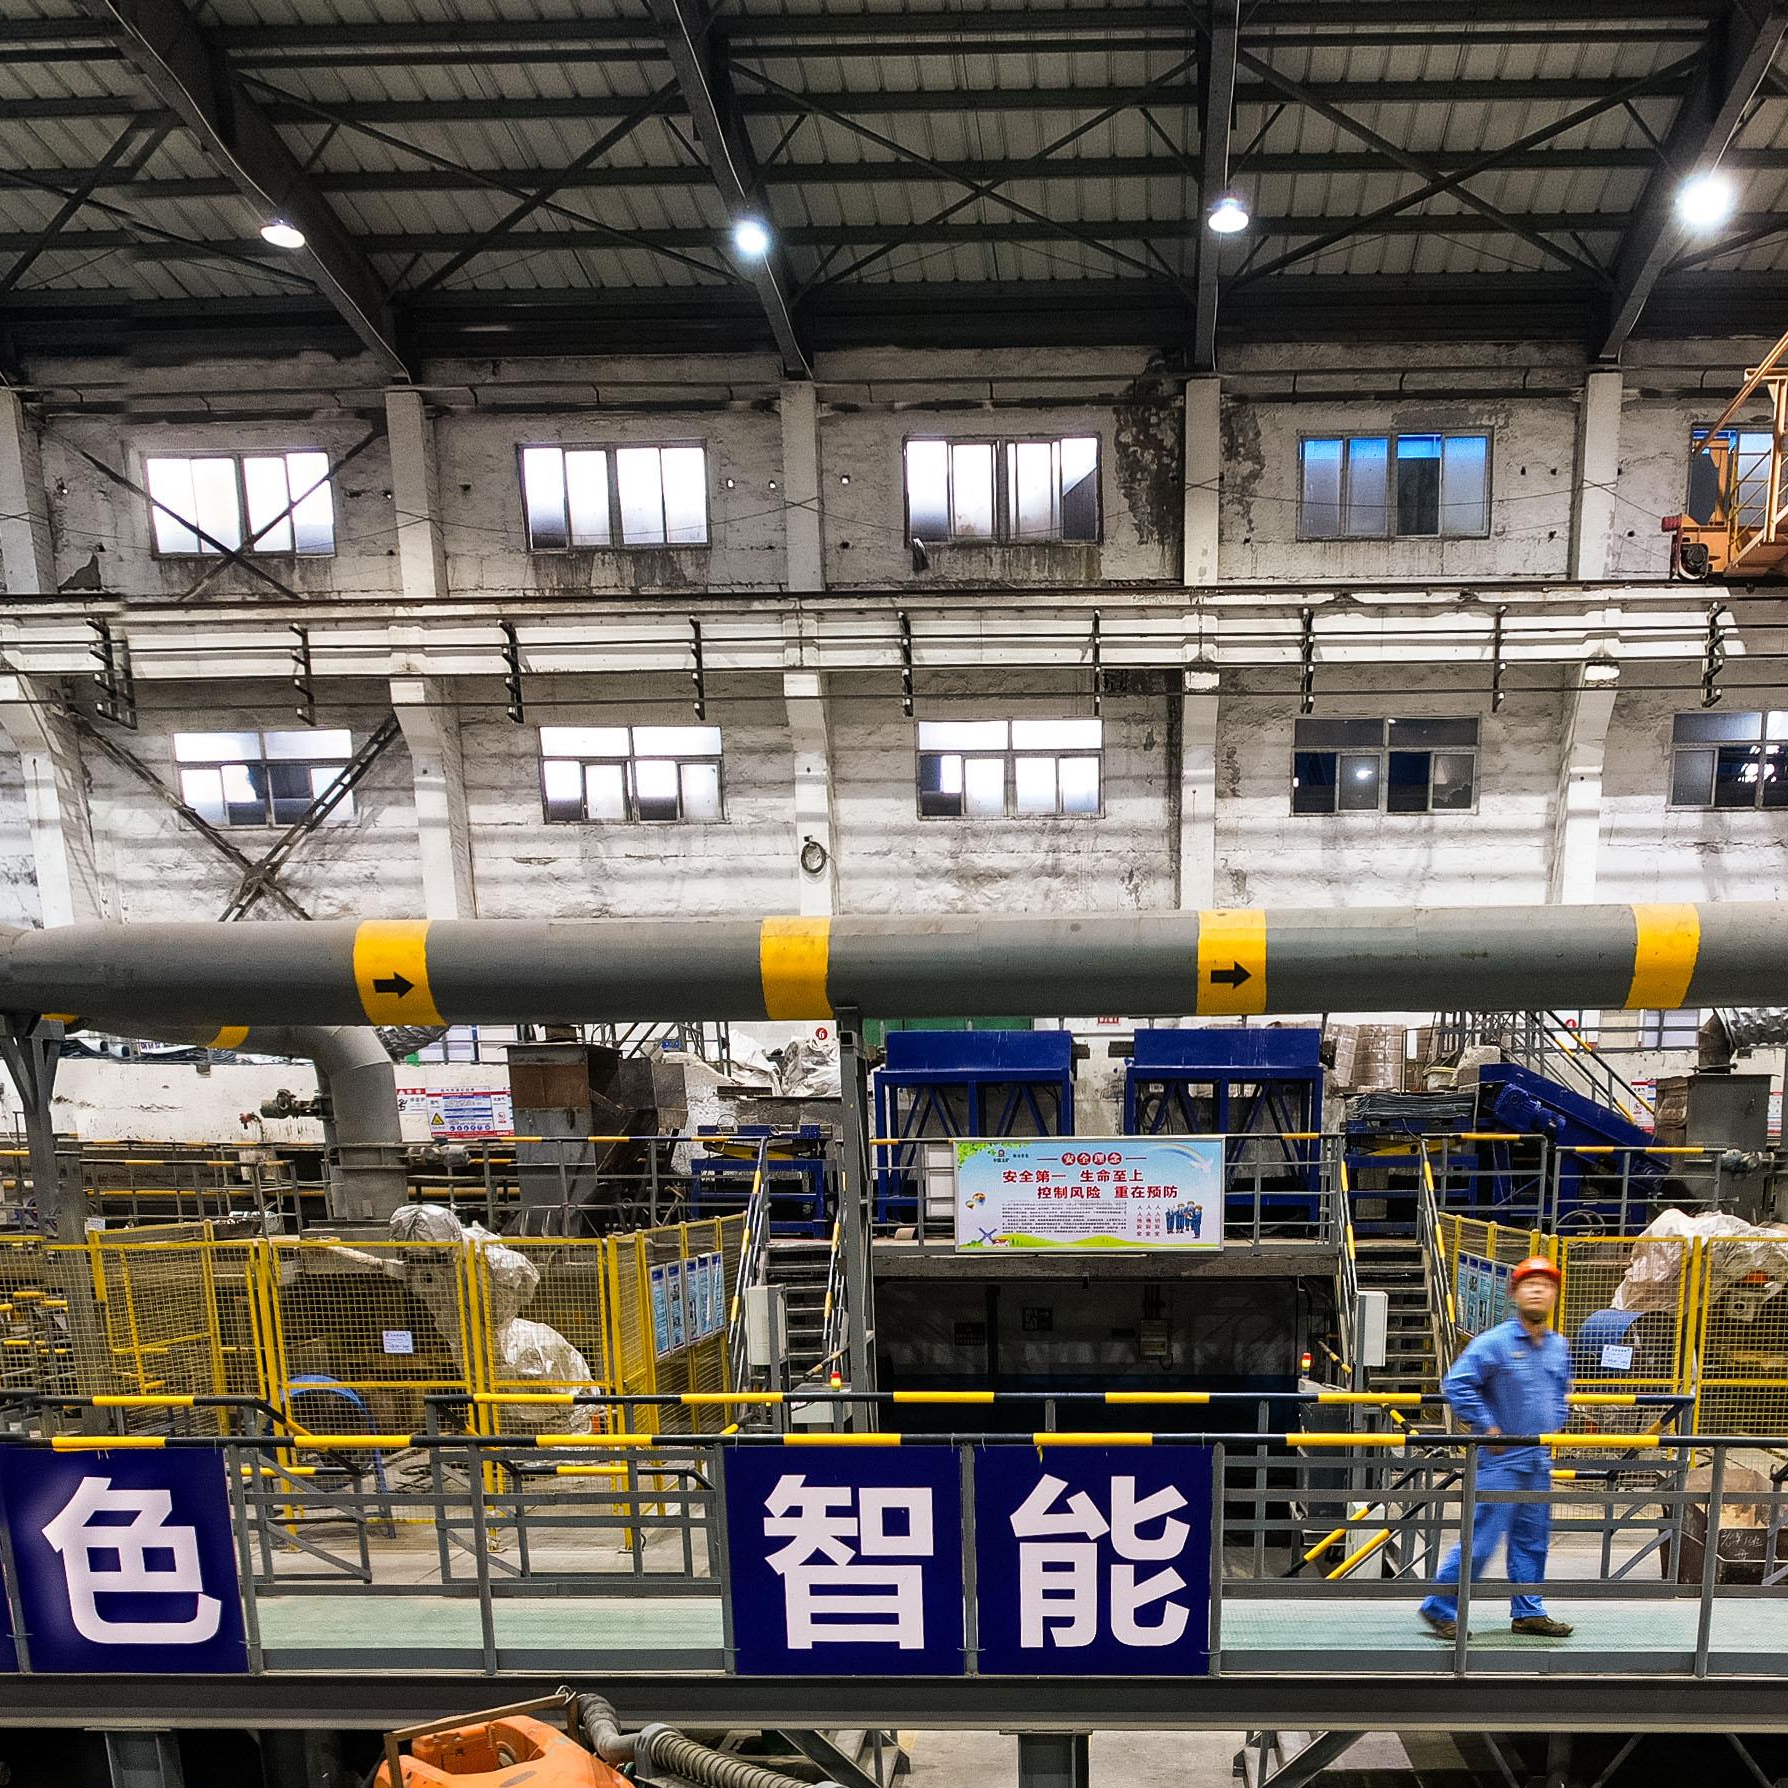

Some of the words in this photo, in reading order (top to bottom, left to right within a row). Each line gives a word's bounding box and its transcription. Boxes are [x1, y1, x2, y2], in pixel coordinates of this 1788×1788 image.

[1063, 1152, 1121, 1165] 安全理念
[1003, 1169, 1067, 1183] 安全第一
[1080, 1169, 1144, 1183] 生命至上
[1037, 1185, 1101, 1199] 控制风险
[1115, 1185, 1178, 1199] 重在预防
[763, 1473, 1191, 1650] 智能
